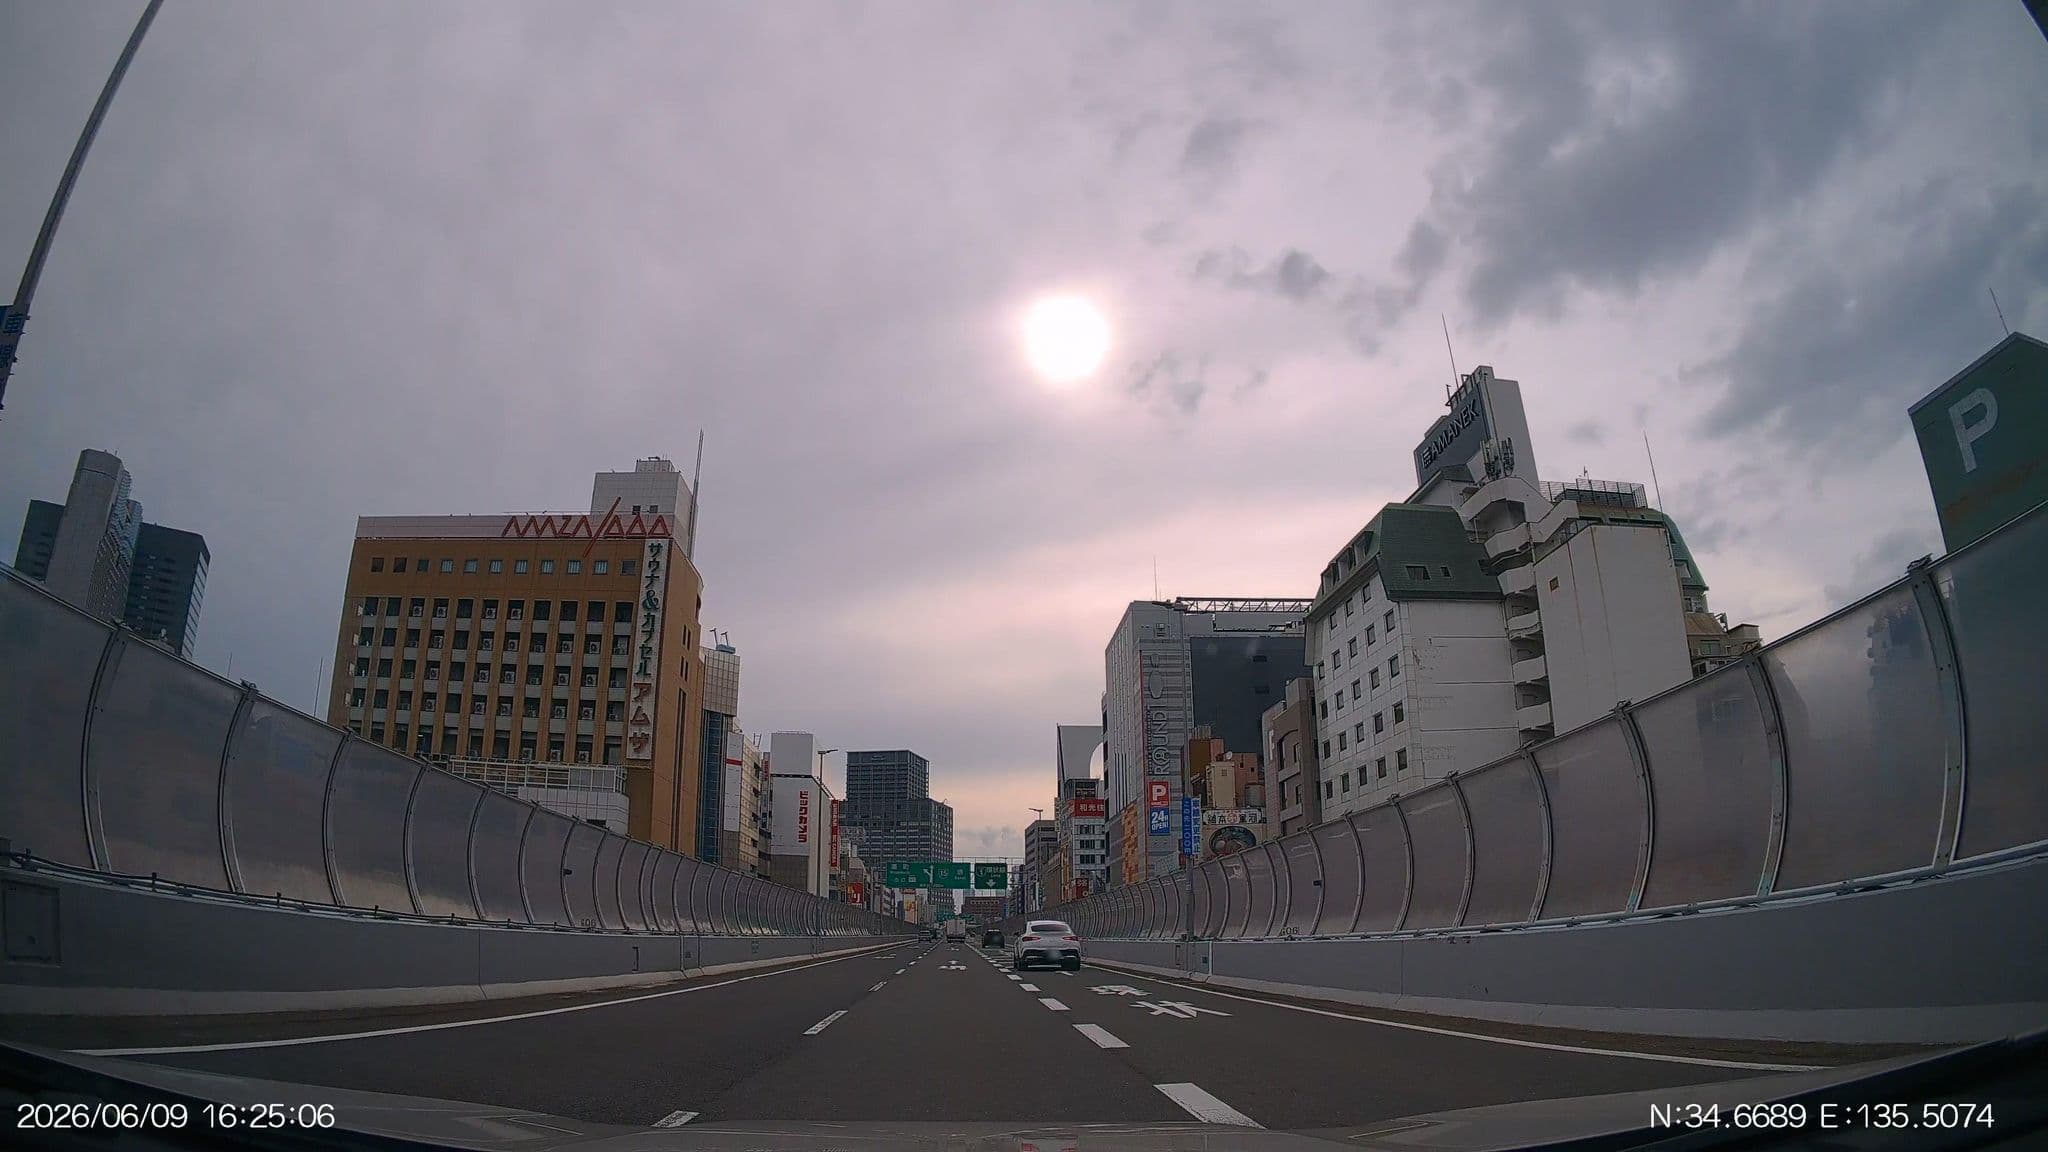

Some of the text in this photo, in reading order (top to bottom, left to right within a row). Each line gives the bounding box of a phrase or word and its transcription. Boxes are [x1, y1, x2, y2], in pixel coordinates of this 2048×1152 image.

[1429, 399, 1479, 455] AMANEK
[1948, 388, 1999, 474] P
[629, 682, 653, 754] アムザ
[1152, 784, 1166, 801] P
